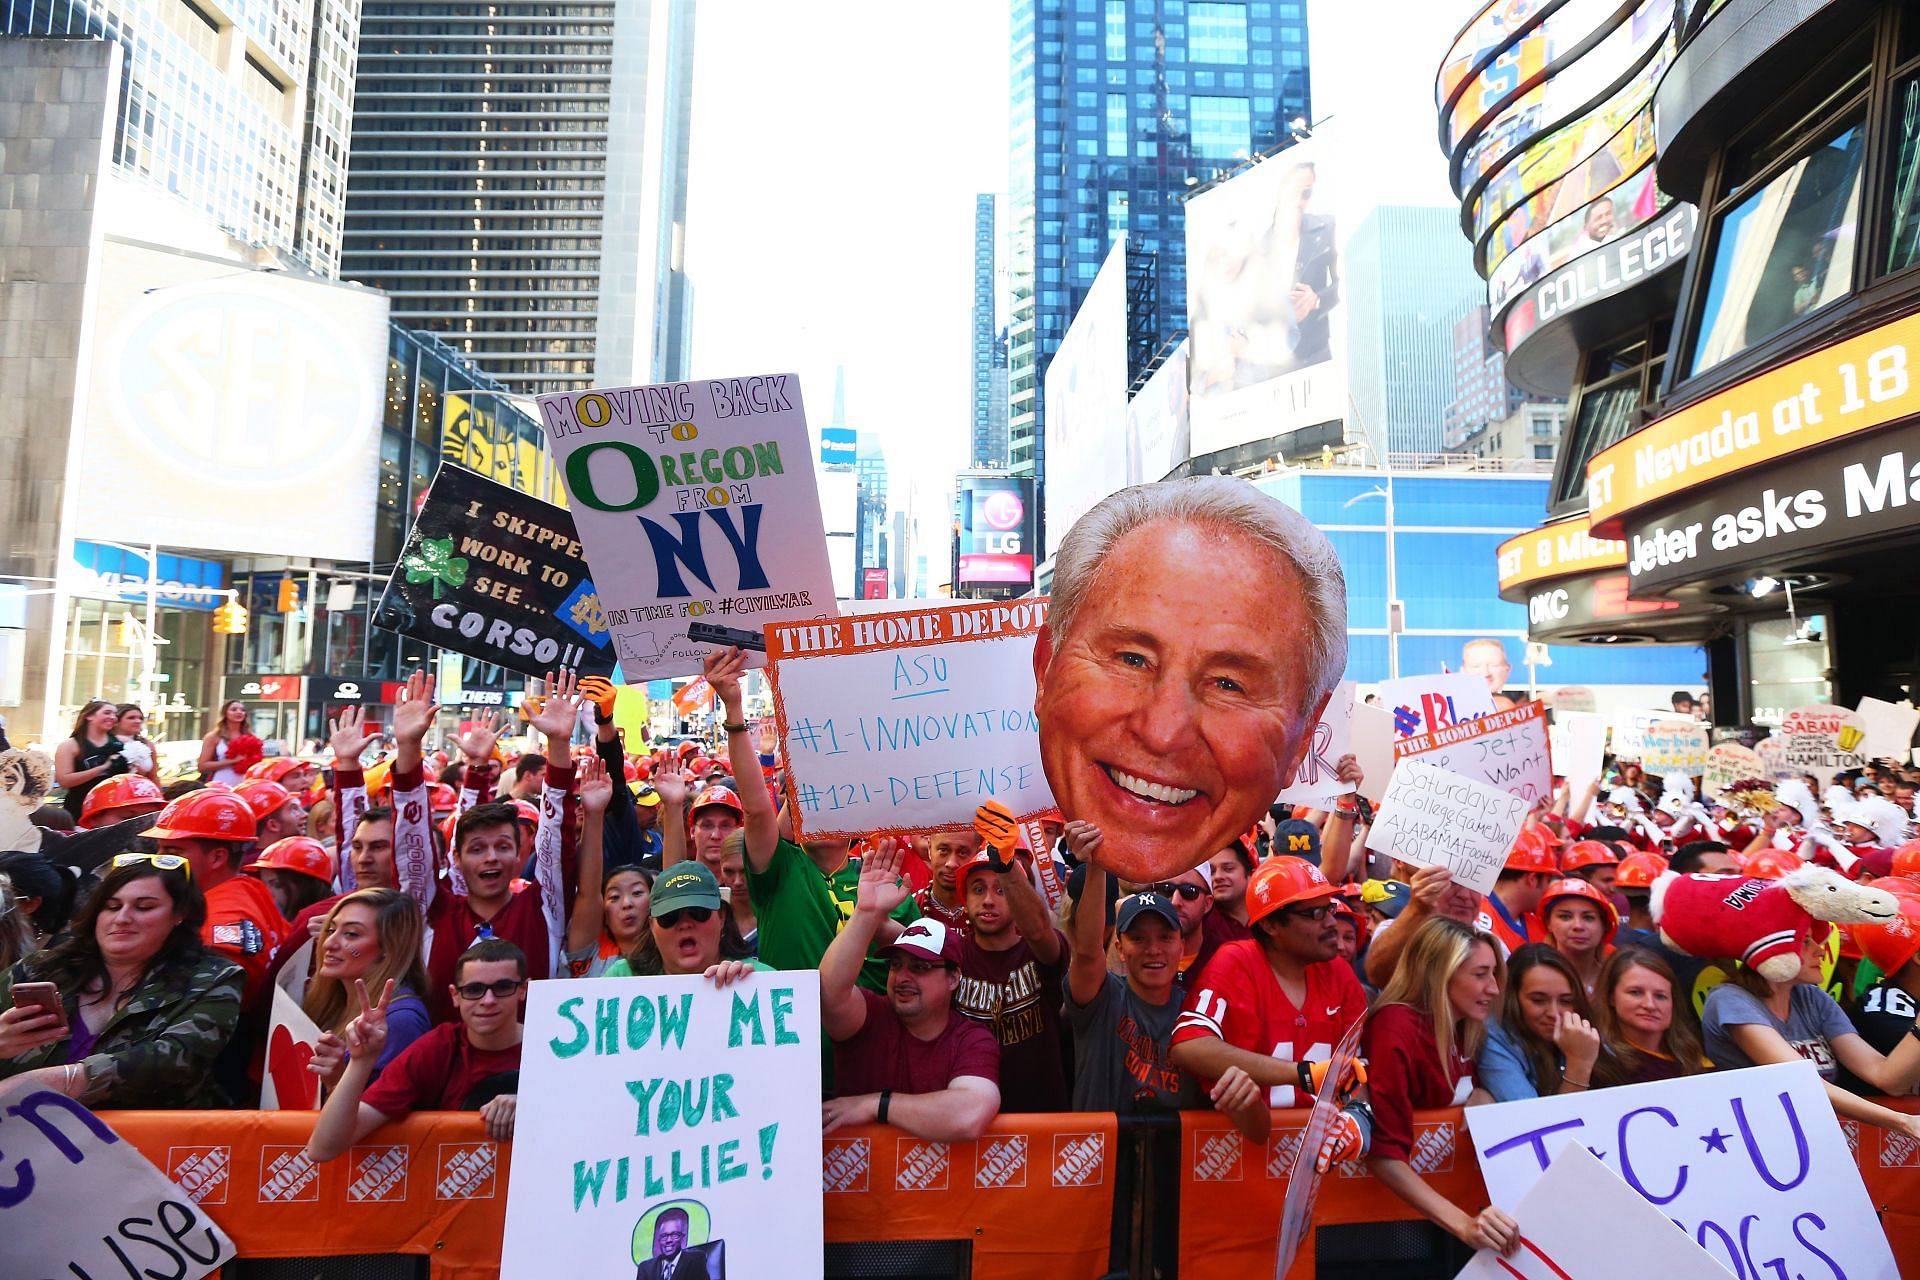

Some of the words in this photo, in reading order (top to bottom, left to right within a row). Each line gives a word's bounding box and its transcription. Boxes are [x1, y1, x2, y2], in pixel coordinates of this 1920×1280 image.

[1537, 213, 1685, 320] COLLEGE
[545, 380, 696, 439] MOVING
[710, 374, 793, 419] BACK
[1634, 410, 1760, 489] Nevada
[1771, 382, 1823, 436] at
[1838, 344, 1909, 414] 18
[647, 421, 698, 445] TO
[565, 440, 785, 512] OREGON
[676, 483, 753, 511] FROM
[465, 500, 483, 519] I
[492, 511, 588, 562] SKIPPE
[985, 532, 1021, 554] LG
[1629, 523, 1703, 577] Jeter
[1712, 488, 1827, 551] asks
[460, 536, 532, 576] WORK
[542, 564, 569, 588] TO
[636, 503, 771, 598] NY
[1536, 538, 1552, 568] 8
[608, 609, 627, 627] IN
[630, 603, 675, 625] TIME
[678, 599, 716, 620] FOR
[718, 590, 813, 616] #CIVILWAR
[1529, 589, 1569, 624] OKC
[431, 603, 585, 674] CORSO!!
[775, 624, 843, 653] THE
[851, 614, 943, 647] HOME
[950, 602, 1050, 636] DEPOT
[672, 648, 712, 659] FOLLOW
[893, 654, 948, 691] ASU
[1395, 736, 1432, 757] THE
[1433, 722, 1482, 746] HOME
[1484, 704, 1537, 732] DEPOT
[1782, 721, 1840, 734] SABAN
[1485, 752, 1544, 785] Want
[1786, 753, 1868, 768] HAMILTON
[1396, 760, 1501, 817] Saturdays
[1505, 798, 1524, 827] R
[1288, 834, 1311, 851] M
[1384, 813, 1464, 854] ALABAMA
[1391, 832, 1438, 866] ROLL
[1442, 849, 1488, 884] TIDE
[665, 874, 702, 888] OREGON
[1139, 893, 1156, 906] NY
[1197, 988, 1228, 1026] 11
[1864, 986, 1916, 1018] 16
[549, 993, 694, 1059] SHOW
[727, 987, 800, 1048] ME
[625, 1073, 741, 1137] YOUR
[902, 1143, 925, 1165] THE
[981, 1140, 1003, 1162] THE
[1058, 1139, 1080, 1161] THE
[1194, 1128, 1243, 1181] HOME
[1202, 1134, 1220, 1156] THE
[1274, 1134, 1292, 1154] THE
[1409, 1122, 1455, 1175] HOME
[1416, 1128, 1433, 1149] THE
[176, 1146, 230, 1200] OME
[268, 1151, 292, 1173] THE
[347, 1145, 407, 1202] HOME
[357, 1151, 380, 1173] THE
[437, 1142, 496, 1199] HOME
[445, 1149, 469, 1171] THE
[573, 1121, 779, 1213] WILLIE!
[836, 1157, 870, 1192] DEPOT
[897, 1140, 950, 1189] HOME
[917, 1158, 950, 1190] DEPOT
[975, 1134, 1028, 1189] HOME
[995, 1153, 1027, 1187] DEPOT
[1052, 1132, 1105, 1187] HOME
[1071, 1152, 1105, 1186] DEPOT
[1213, 1150, 1243, 1181] DEPOT
[1427, 1143, 1455, 1174] DEPOT
[284, 1164, 319, 1201] DEPOT
[371, 1163, 408, 1201] DEPOT
[458, 1163, 496, 1199] DEPOT
